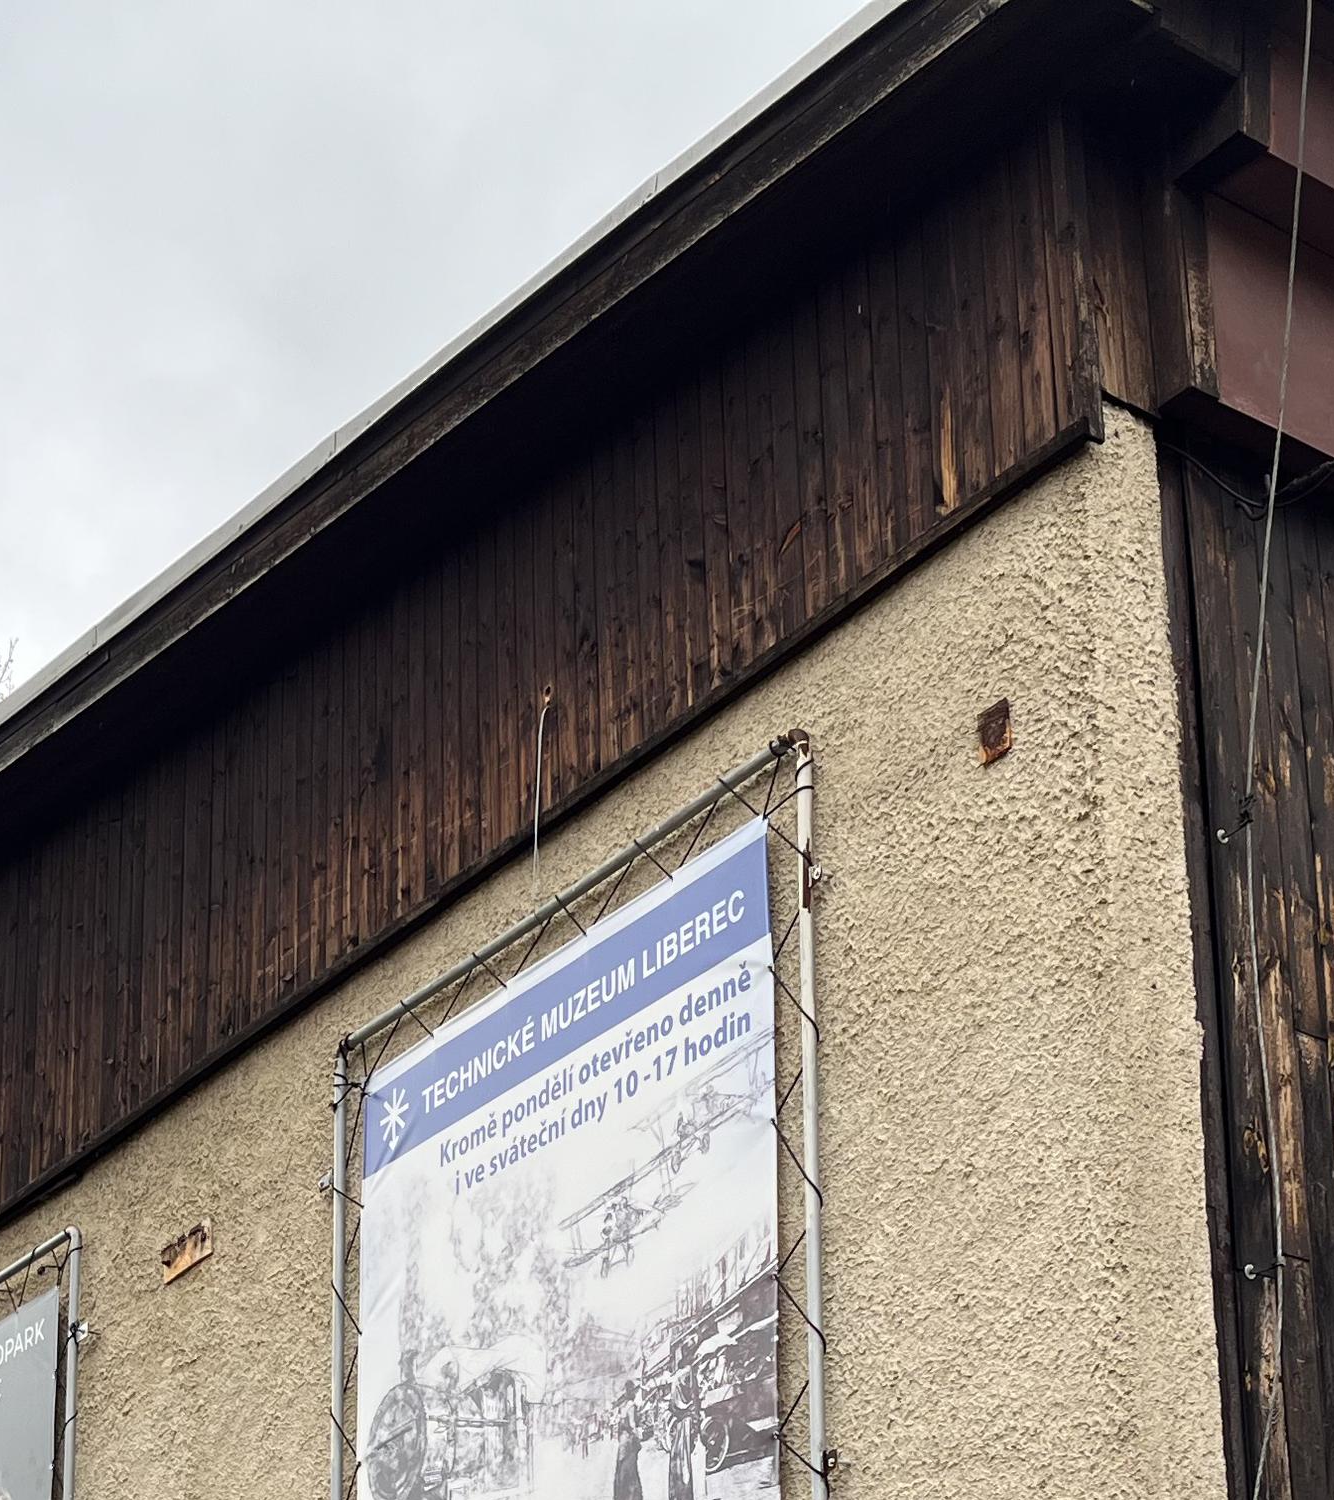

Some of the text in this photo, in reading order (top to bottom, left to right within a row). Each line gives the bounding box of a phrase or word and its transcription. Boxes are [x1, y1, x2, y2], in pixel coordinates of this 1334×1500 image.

[422, 889, 746, 1114] TECHNICKÉ MUZEUM LIBEREC
[440, 961, 752, 1167] Kromě pondělí otevřeno denně
[455, 1169, 462, 1196] i
[464, 1163, 486, 1190] ve
[489, 1116, 565, 1176] sváteční
[571, 1091, 608, 1130] dny
[684, 1011, 751, 1067] hodin
